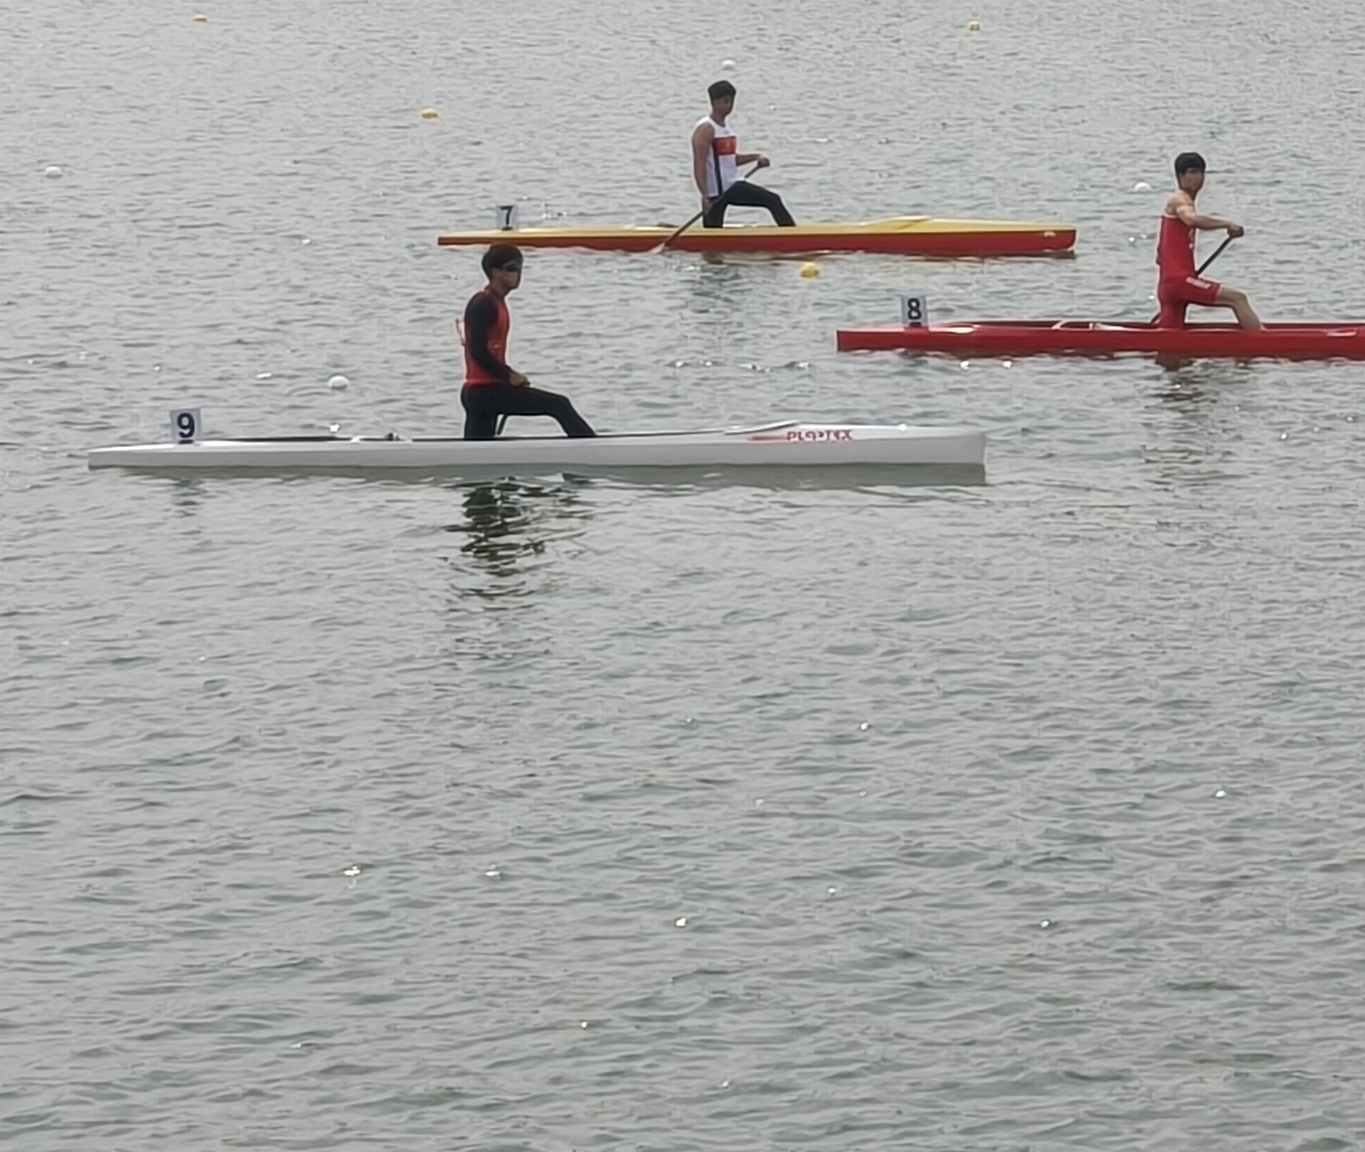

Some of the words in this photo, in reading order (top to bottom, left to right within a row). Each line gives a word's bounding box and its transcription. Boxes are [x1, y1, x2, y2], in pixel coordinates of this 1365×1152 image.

[500, 205, 513, 226] 7
[907, 298, 922, 320] 8
[177, 412, 196, 439] 9
